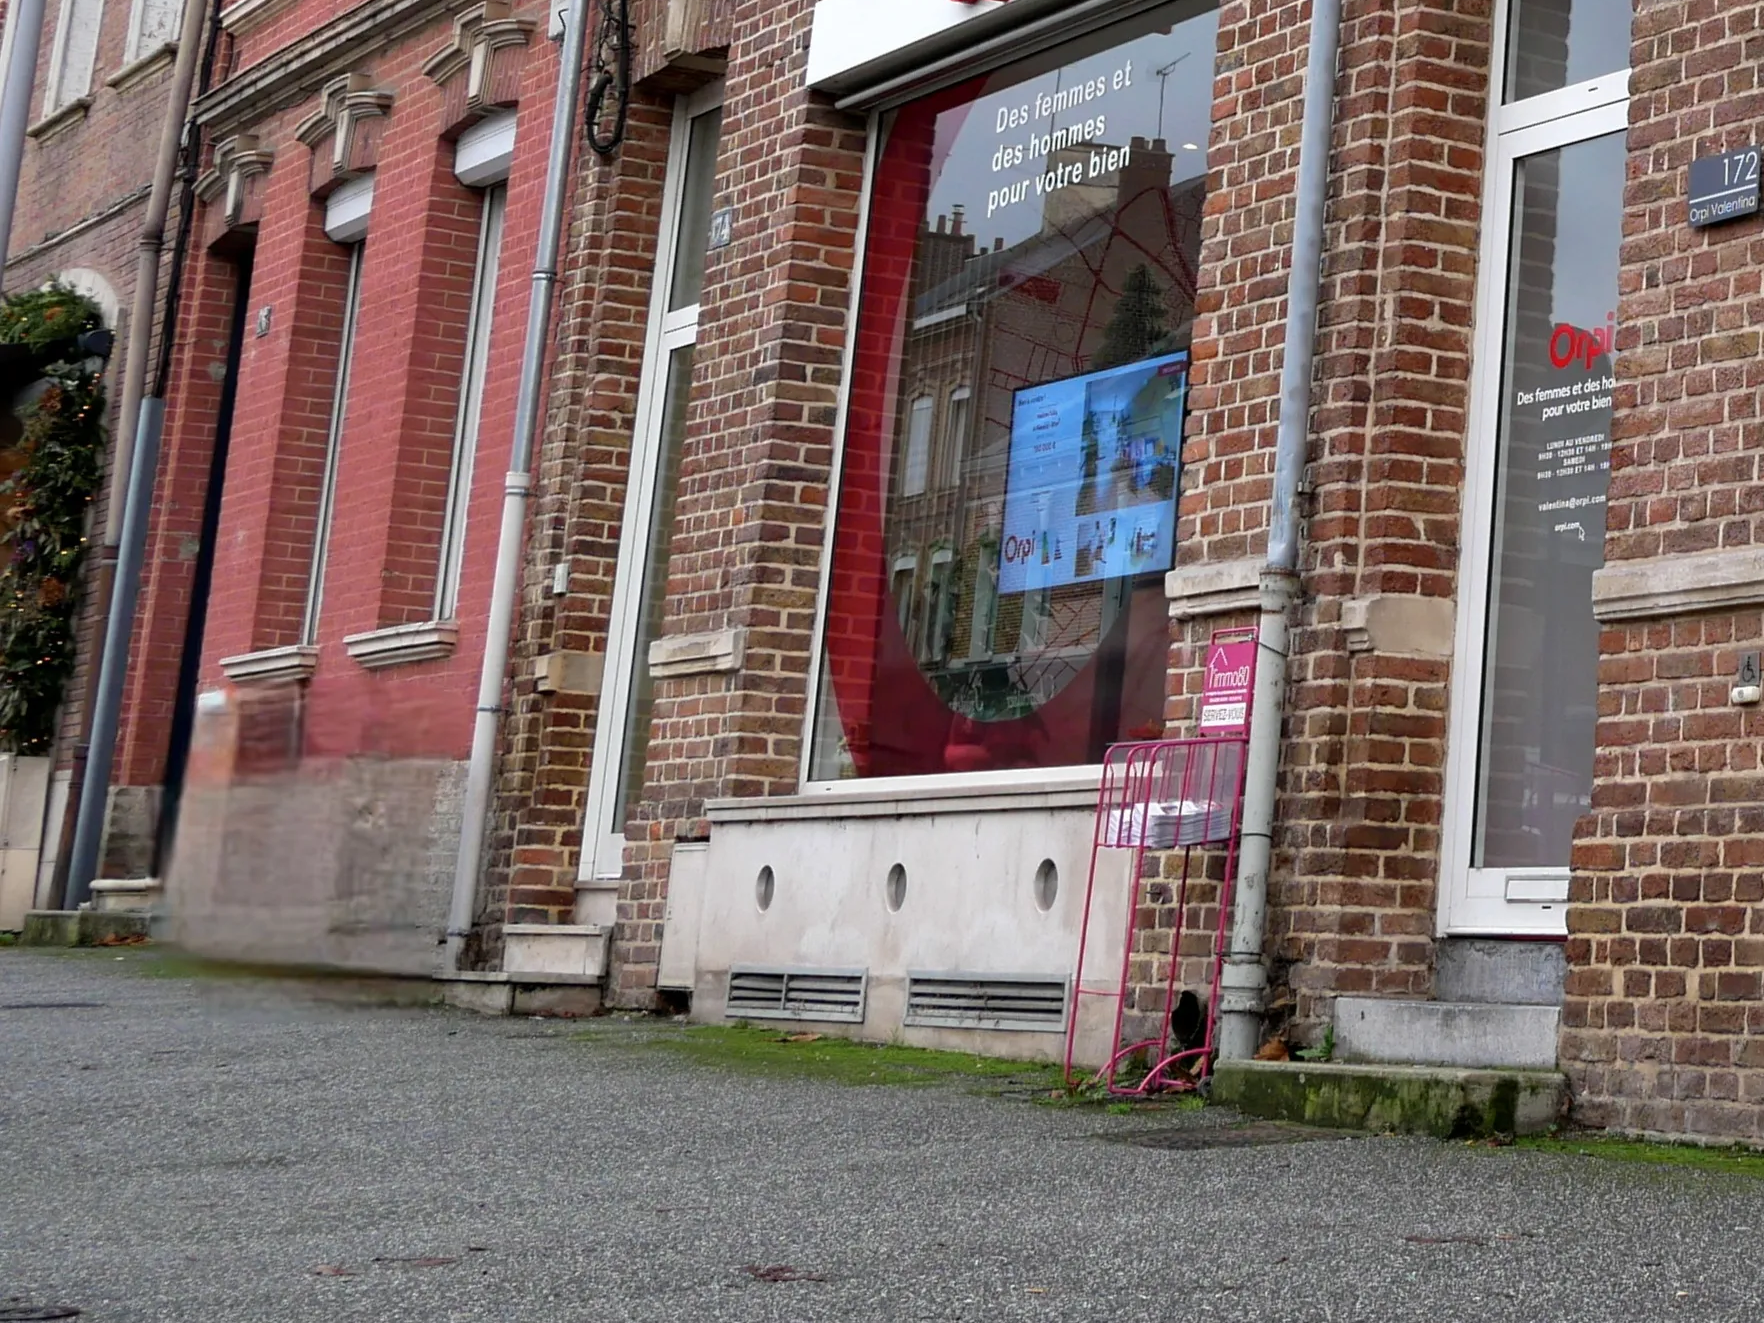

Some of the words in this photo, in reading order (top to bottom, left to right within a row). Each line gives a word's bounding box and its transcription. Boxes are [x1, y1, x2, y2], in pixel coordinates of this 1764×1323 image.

[996, 104, 1029, 133] Des
[1034, 75, 1106, 120] femmes
[1112, 59, 1132, 91] et
[992, 144, 1023, 173] des
[1029, 114, 1106, 160] hommes
[987, 179, 1030, 219] pour
[1035, 161, 1083, 196] votre
[1088, 144, 1131, 179] bien
[1723, 151, 1758, 186] 172
[1689, 205, 1709, 223] Orpi
[1711, 196, 1756, 217] Valentina
[1549, 311, 1615, 371] Orpi
[1517, 391, 1534, 406] Des
[1535, 385, 1571, 403] femmes
[1572, 381, 1583, 395] et
[1583, 378, 1600, 393] des
[1542, 404, 1565, 422] pour
[1566, 398, 1590, 414] votre
[1591, 394, 1612, 410] bien
[1546, 440, 1565, 451] LUNDI
[1565, 438, 1574, 447] AU
[1574, 433, 1605, 446] VENDREDI
[1575, 446, 1584, 455] ET
[1563, 455, 1586, 467] SAMEDI
[1574, 465, 1583, 474] ET
[1538, 494, 1606, 512] valentina@orpi.com
[1554, 521, 1580, 533] orpi.com
[1005, 529, 1036, 565] Orpi
